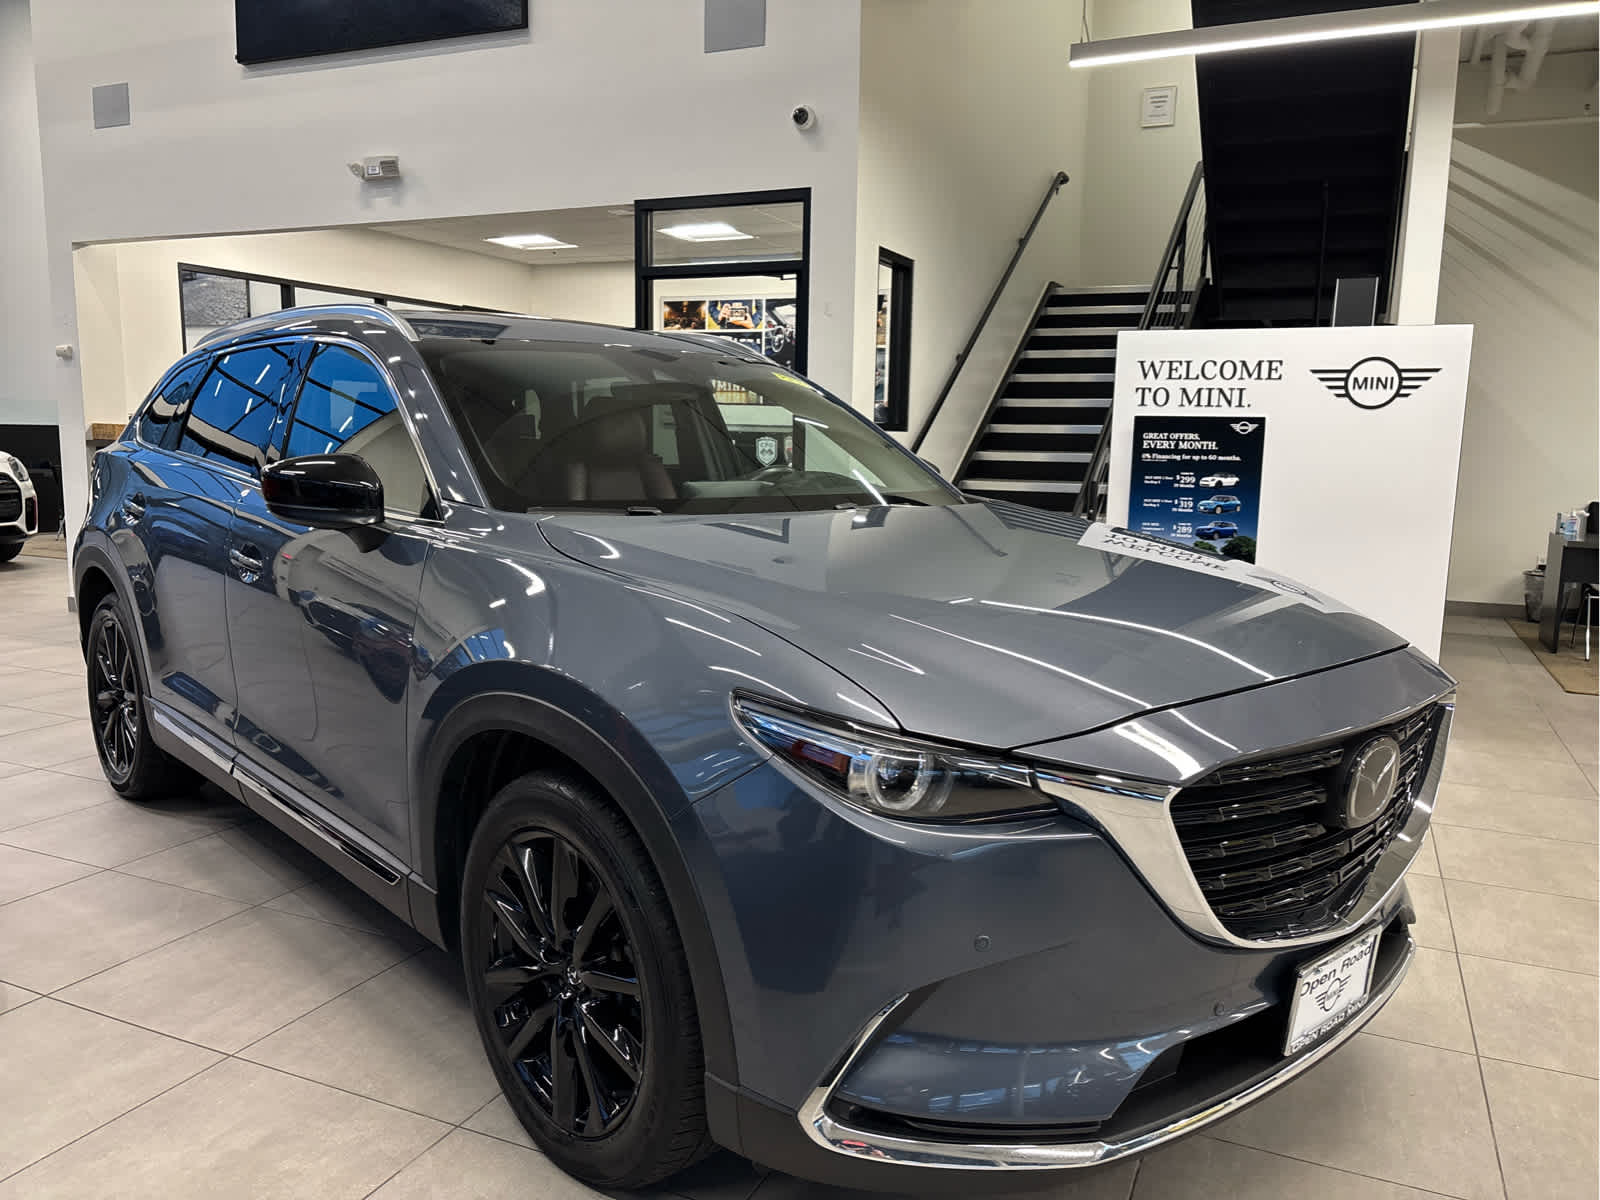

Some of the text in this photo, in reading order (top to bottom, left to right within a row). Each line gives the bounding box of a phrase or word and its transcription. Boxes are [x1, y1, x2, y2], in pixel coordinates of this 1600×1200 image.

[1136, 359, 1284, 381] WELCOME
[1352, 375, 1395, 391] MINI
[1135, 386, 1252, 409] TO MINI.
[1142, 440, 1218, 450] EVERY MONTH.
[1152, 453, 1181, 461] Financing
[1300, 942, 1374, 997] Open Road
